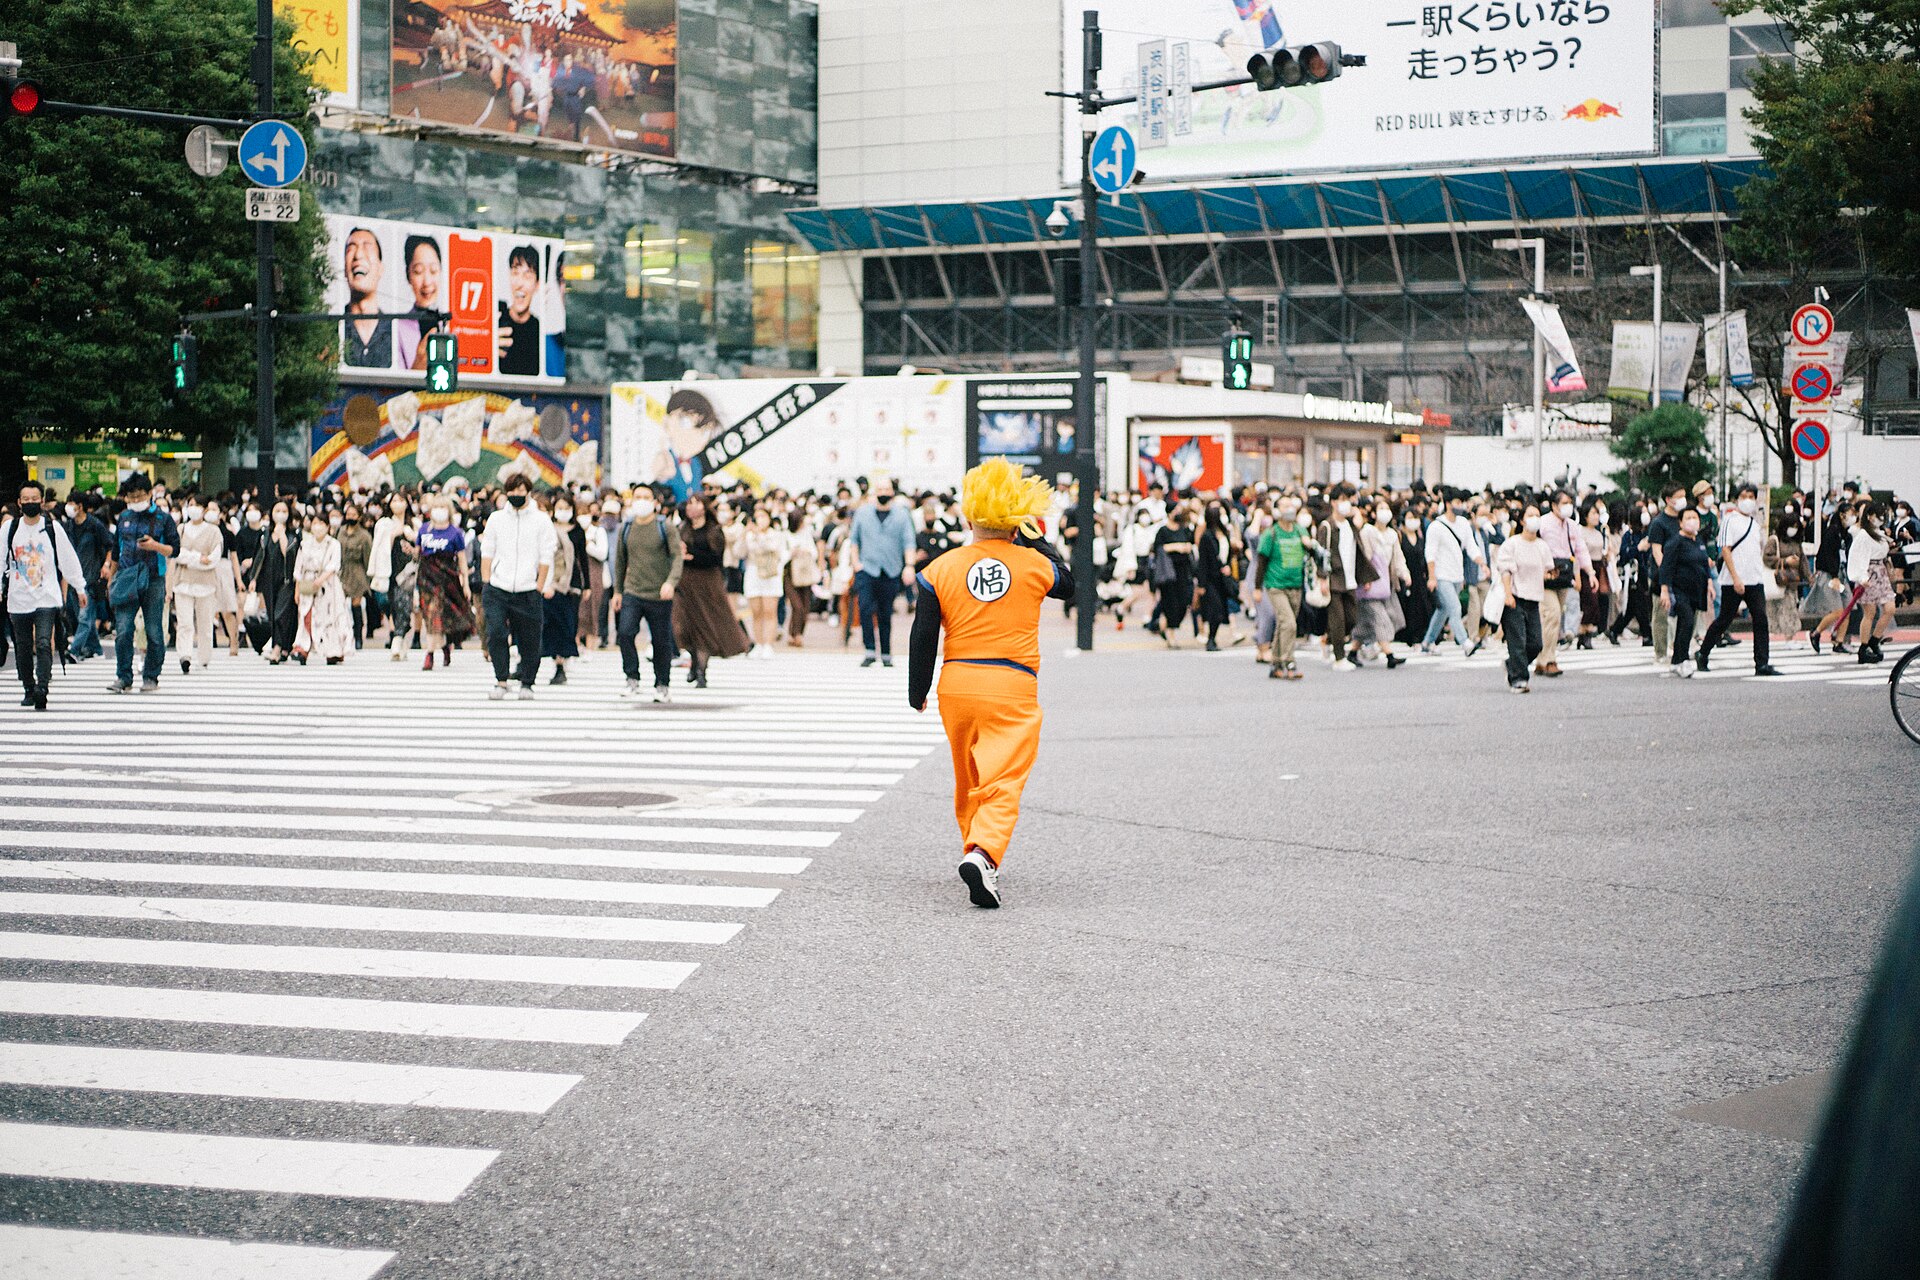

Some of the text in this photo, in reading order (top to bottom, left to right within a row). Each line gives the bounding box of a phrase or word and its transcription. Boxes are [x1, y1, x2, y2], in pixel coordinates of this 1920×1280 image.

[1386, 0, 1610, 38] 一駅くらいなら
[1408, 37, 1582, 80] 走っちゃう?
[1375, 116, 1404, 132] RED
[1409, 113, 1444, 130] BULL
[460, 281, 484, 312] 17
[972, 563, 1006, 595] 悟
